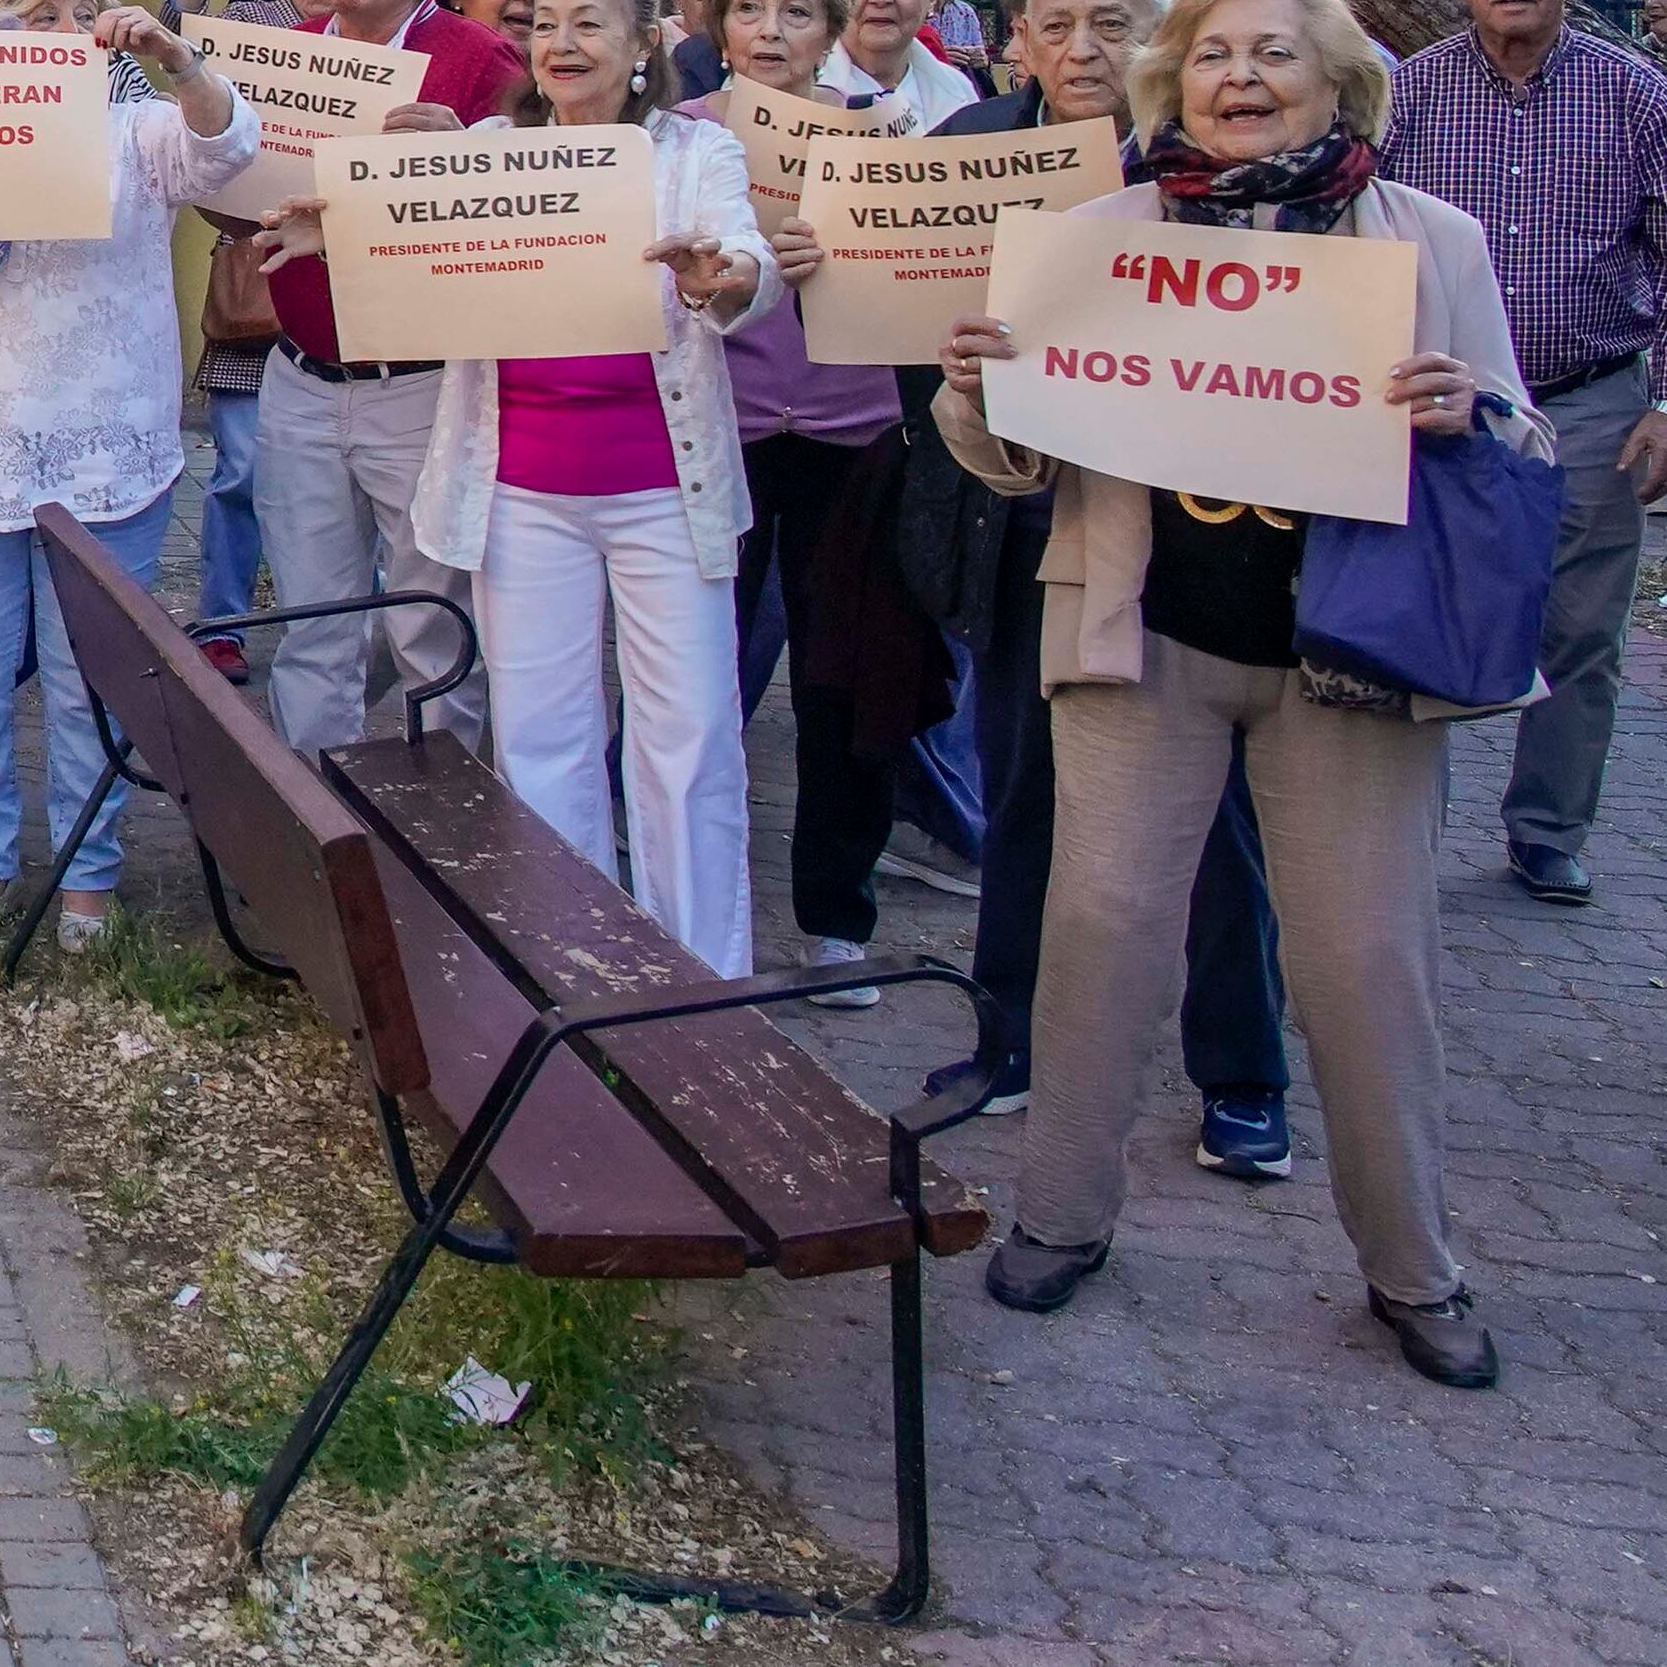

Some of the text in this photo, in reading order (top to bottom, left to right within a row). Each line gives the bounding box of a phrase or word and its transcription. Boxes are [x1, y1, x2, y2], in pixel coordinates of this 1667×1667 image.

[350, 145, 616, 181] D. JESUS NUÑEZ
[822, 162, 840, 182] D.
[850, 162, 947, 183] JESUS
[959, 148, 1080, 180] NUÑEZ
[387, 193, 580, 223] VELAZQUEZ
[370, 234, 606, 256] PRESIDENTE DE LA FUNDACION
[432, 260, 543, 275] MONTEMADRID
[1045, 346, 1361, 407] NOS VAMOS
